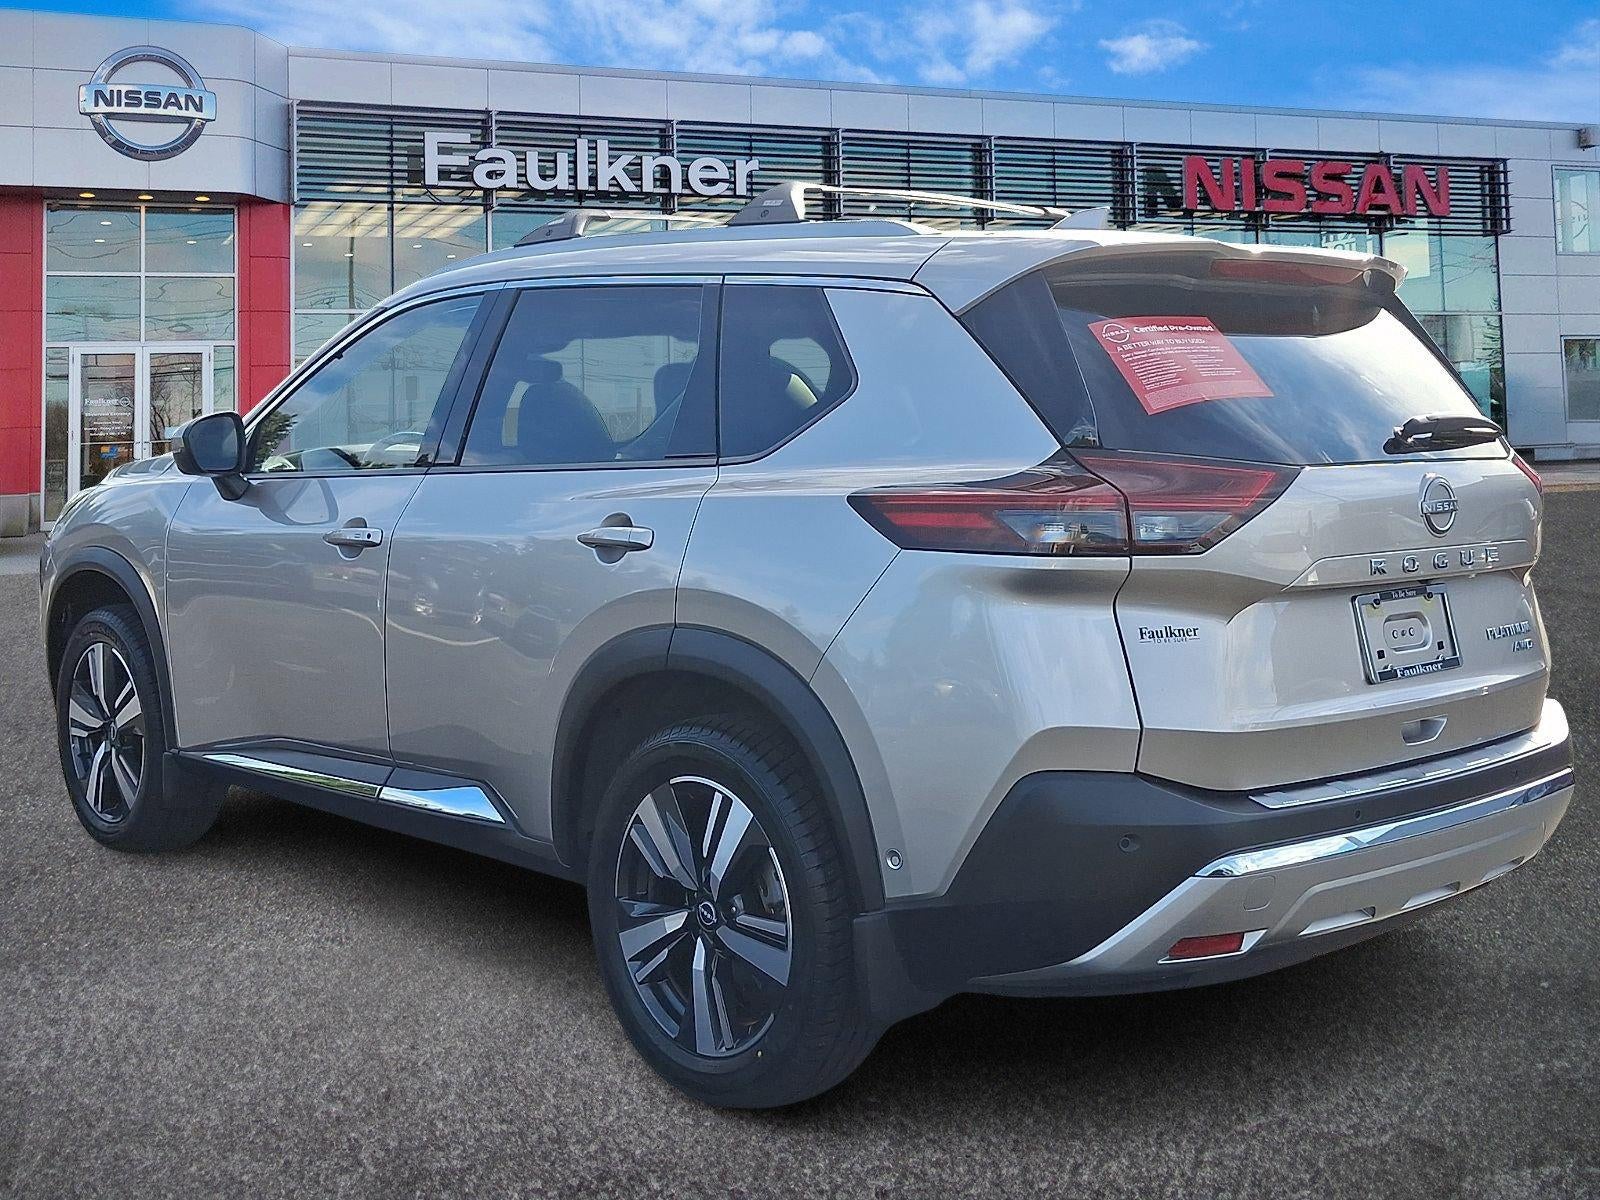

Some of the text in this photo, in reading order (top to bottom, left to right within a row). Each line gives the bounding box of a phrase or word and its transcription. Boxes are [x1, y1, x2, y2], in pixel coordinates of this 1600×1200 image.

[94, 89, 203, 113] NISSAN
[423, 131, 760, 197] Faulkner
[1182, 155, 1450, 216] NISSAN
[1133, 325, 1170, 333] Certified
[1123, 341, 1150, 351] BETTER
[1424, 501, 1459, 512] NISSAN
[1369, 547, 1500, 576] ROGUE
[1139, 626, 1199, 640] Faulkner
[1485, 620, 1530, 640] PLATINUM
[1512, 638, 1533, 652] AWD
[1396, 662, 1443, 678] Faulkner
